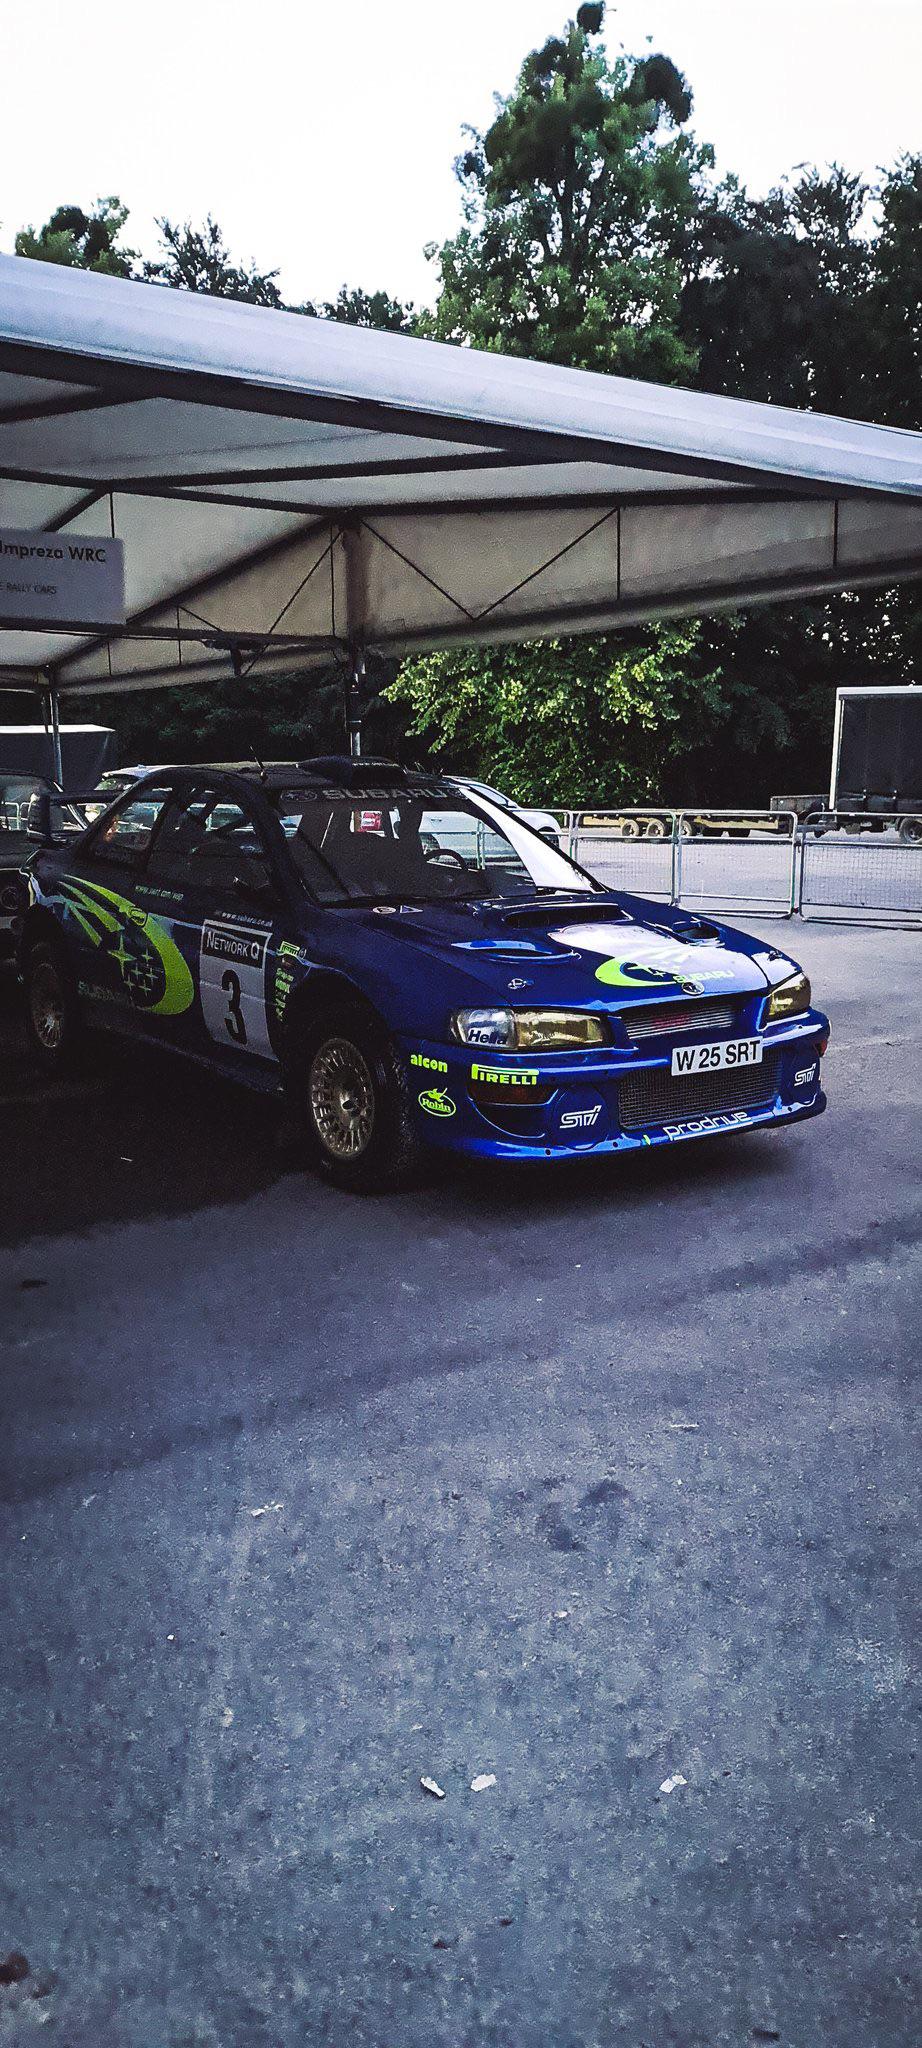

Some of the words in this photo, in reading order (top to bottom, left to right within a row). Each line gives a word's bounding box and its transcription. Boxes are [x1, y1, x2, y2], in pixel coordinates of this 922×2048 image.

[69, 546, 106, 562] WRC
[7, 583, 31, 593] RALLY
[34, 585, 57, 595] CARS
[321, 789, 447, 800] SUBARU
[207, 931, 249, 957] NETWORK
[250, 942, 260, 960] Q
[221, 969, 248, 1045] 3
[468, 1029, 507, 1045] Hella
[410, 1054, 448, 1073] alcon
[676, 1050, 695, 1072] W
[698, 1047, 720, 1069] 25
[725, 1040, 760, 1065] SRT
[471, 1063, 539, 1085] PIRELLI
[421, 1098, 451, 1113] Robin
[664, 1111, 752, 1141] prodrive
